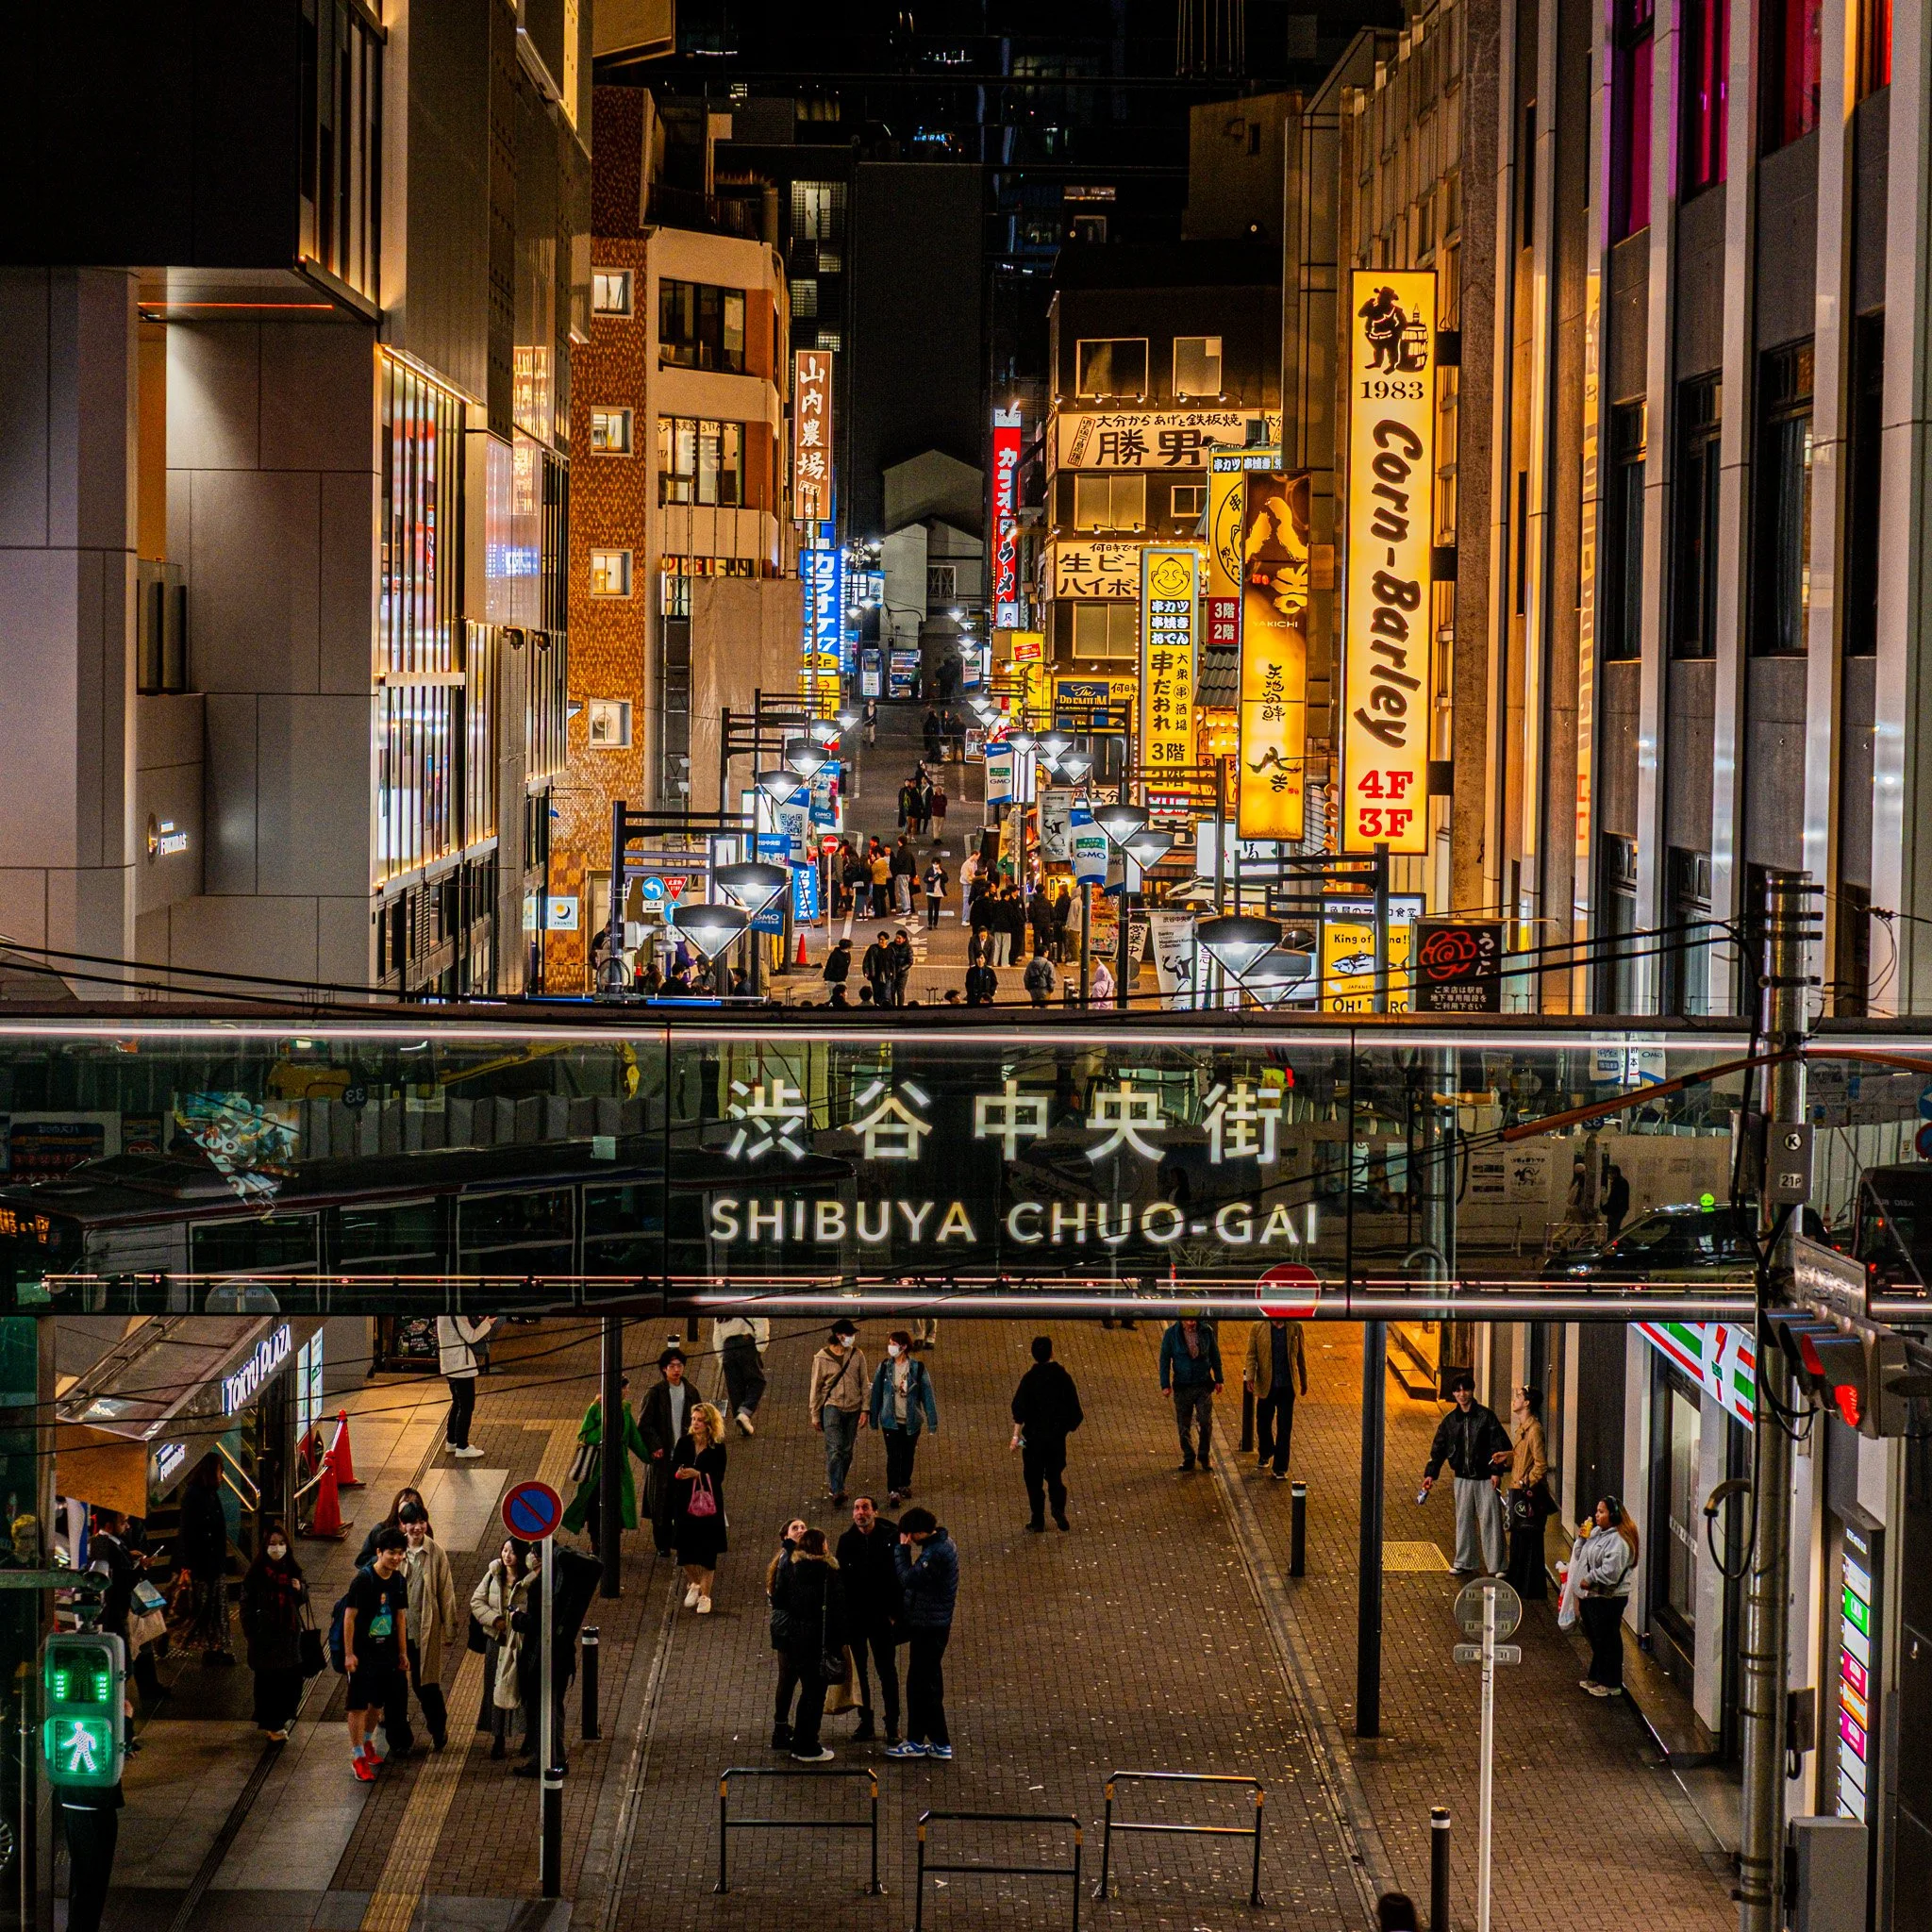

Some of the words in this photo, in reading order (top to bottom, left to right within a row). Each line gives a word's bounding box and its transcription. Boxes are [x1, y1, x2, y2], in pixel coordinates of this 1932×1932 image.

[1360, 380, 1424, 400] 1983
[797, 356, 825, 480] 山内農場
[1213, 458, 1241, 472] 串カツ
[1353, 419, 1424, 748] Corn-Barley
[1151, 600, 1190, 613] 串カツ
[1214, 603, 1235, 619] 3階
[1151, 616, 1189, 629] 串焼き
[1213, 623, 1235, 641] 2階
[1253, 620, 1299, 628] YAKICHI
[1151, 632, 1190, 645] おでん
[1151, 649, 1174, 732] 串だおれ
[1151, 742, 1186, 762] 3階
[1358, 770, 1413, 799] 4F
[1358, 808, 1413, 838] 3F
[798, 870, 811, 908] カラオケ
[1334, 934, 1357, 944] King
[1360, 934, 1373, 943] of
[726, 1078, 1282, 1164] 渋谷中央街
[1787, 1135, 1800, 1147] K
[1781, 1174, 1802, 1187] 21P
[710, 1200, 976, 1242] SHIBUYA
[1008, 1201, 1317, 1244] CHUO-GAI
[224, 1356, 259, 1416] TOKYU
[259, 1324, 291, 1381] PLAZA
